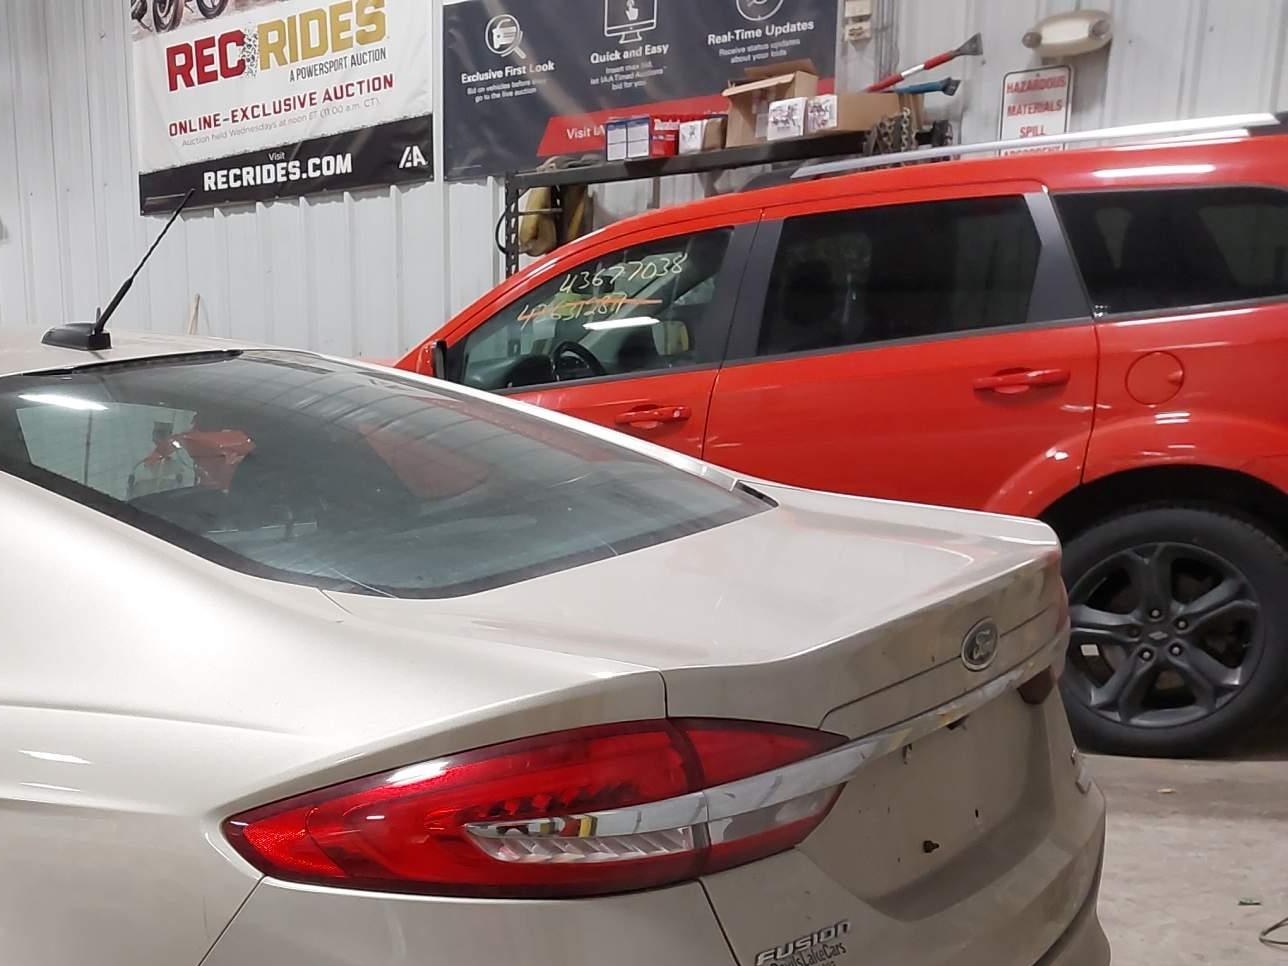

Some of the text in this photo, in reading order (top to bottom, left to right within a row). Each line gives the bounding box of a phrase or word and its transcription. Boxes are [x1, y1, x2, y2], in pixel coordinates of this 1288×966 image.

[708, 21, 814, 45] Real-Time Updates
[166, 0, 387, 92] REC RIDES
[590, 44, 669, 64] Quick and Easy
[289, 47, 387, 82] A POWERSPORT AUCTION
[461, 60, 555, 84] Exclusive First Look
[1006, 75, 1066, 94] HAZARDOUS
[169, 73, 394, 137] ONLINE-EXCLUSIVE AUCTION
[1007, 99, 1063, 116] MATERIALS
[566, 128, 591, 139] Visit
[1019, 124, 1046, 138] SPILL
[269, 151, 286, 162] Visit
[203, 152, 353, 192] RECRIDES.COM
[559, 253, 688, 293] 43677038
